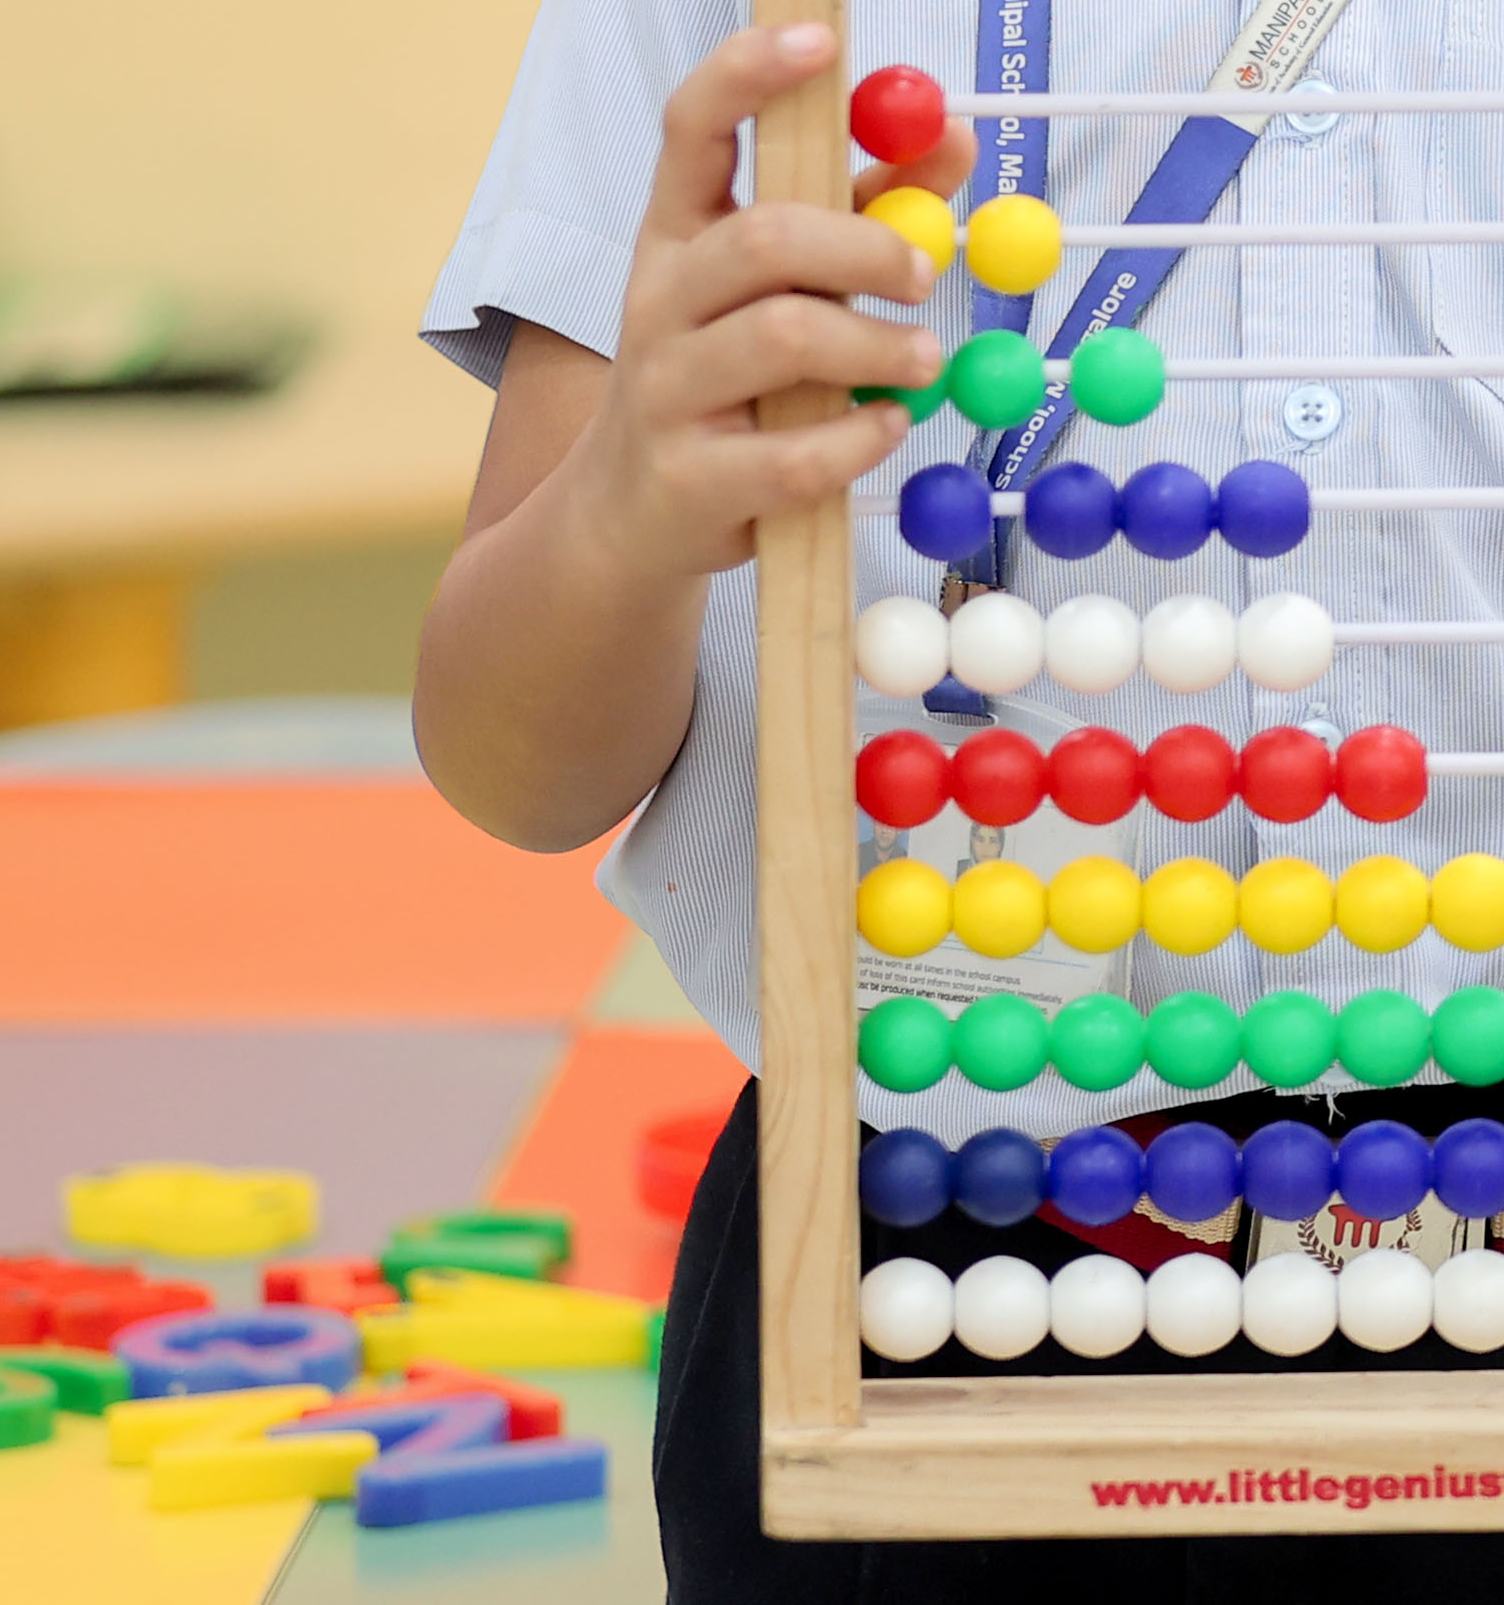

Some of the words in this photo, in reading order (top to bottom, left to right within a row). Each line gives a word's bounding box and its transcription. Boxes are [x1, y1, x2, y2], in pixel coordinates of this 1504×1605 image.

[996, 54, 1026, 146] Schol,
[997, 154, 1023, 197] Ma
[874, 958, 883, 966] be
[954, 969, 966, 977] the
[968, 971, 991, 981] school
[870, 982, 879, 991] be
[881, 984, 914, 995] produced
[916, 989, 936, 998] when
[938, 992, 973, 1003] requested
[885, 972, 892, 980] of
[927, 978, 950, 987] inform
[953, 981, 975, 991] school
